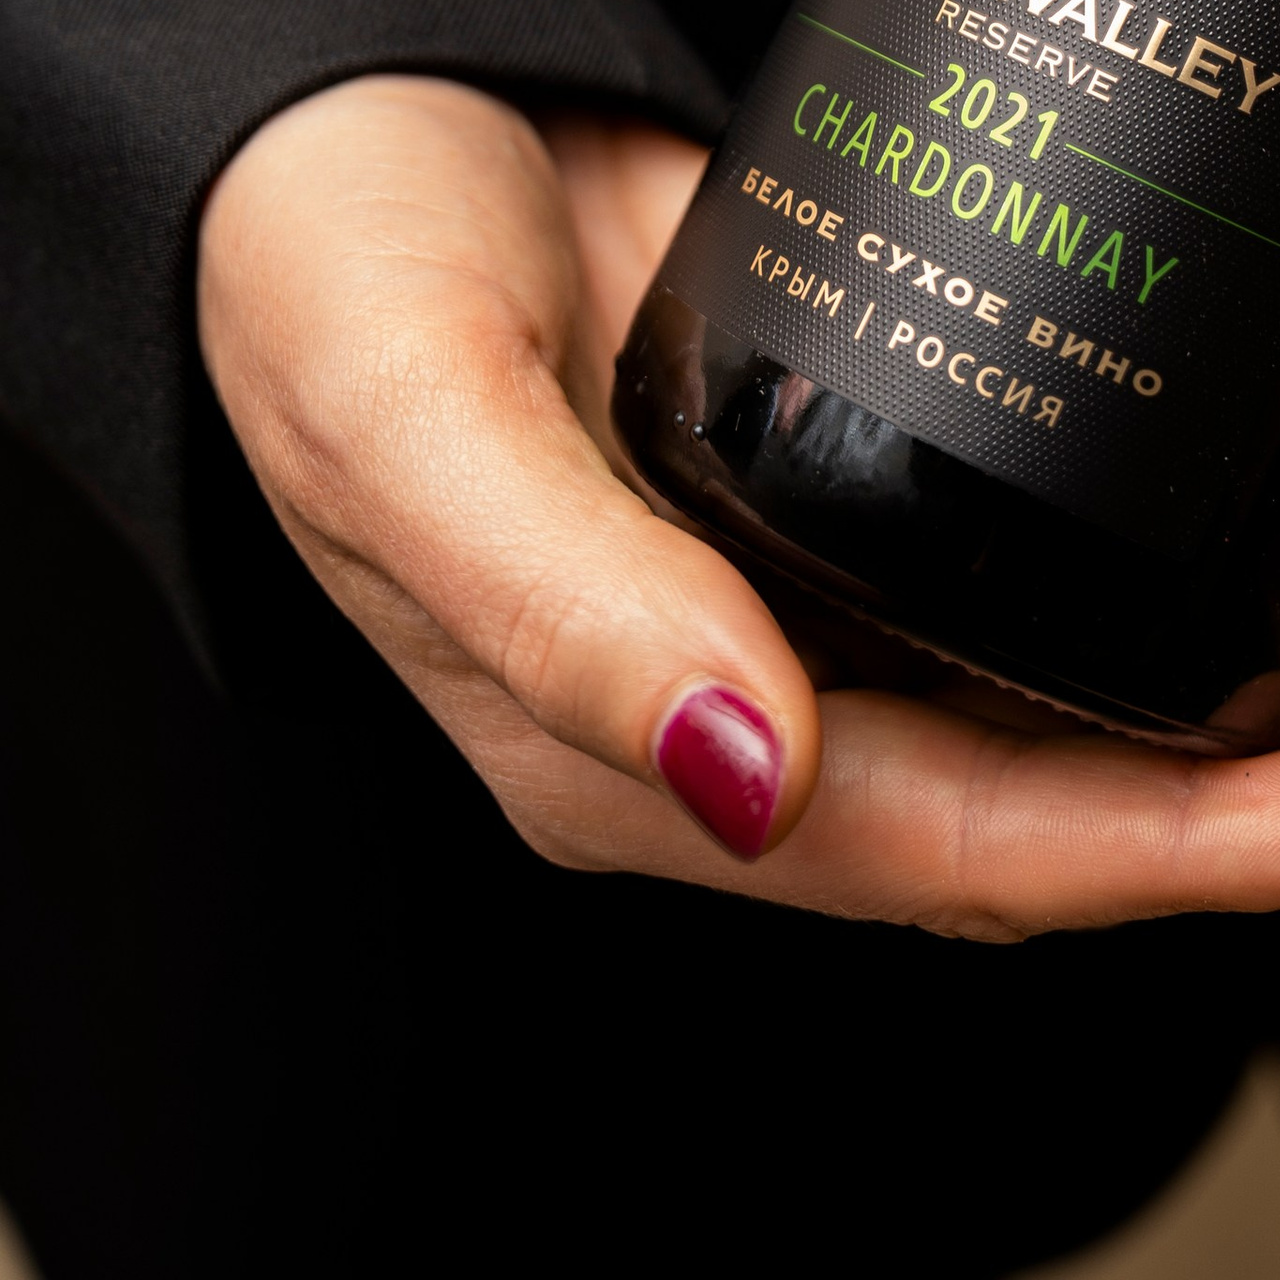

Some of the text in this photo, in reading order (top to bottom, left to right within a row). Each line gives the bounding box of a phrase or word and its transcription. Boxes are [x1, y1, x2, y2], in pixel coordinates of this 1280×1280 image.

[793, 83, 1179, 305] CHARDONNAY
[928, 63, 1059, 161] 2021
[740, 166, 1163, 397] БЕЛОЕ СУХОЕ ВИНО
[749, 245, 1064, 427] КРЫМ РОССИЯ
